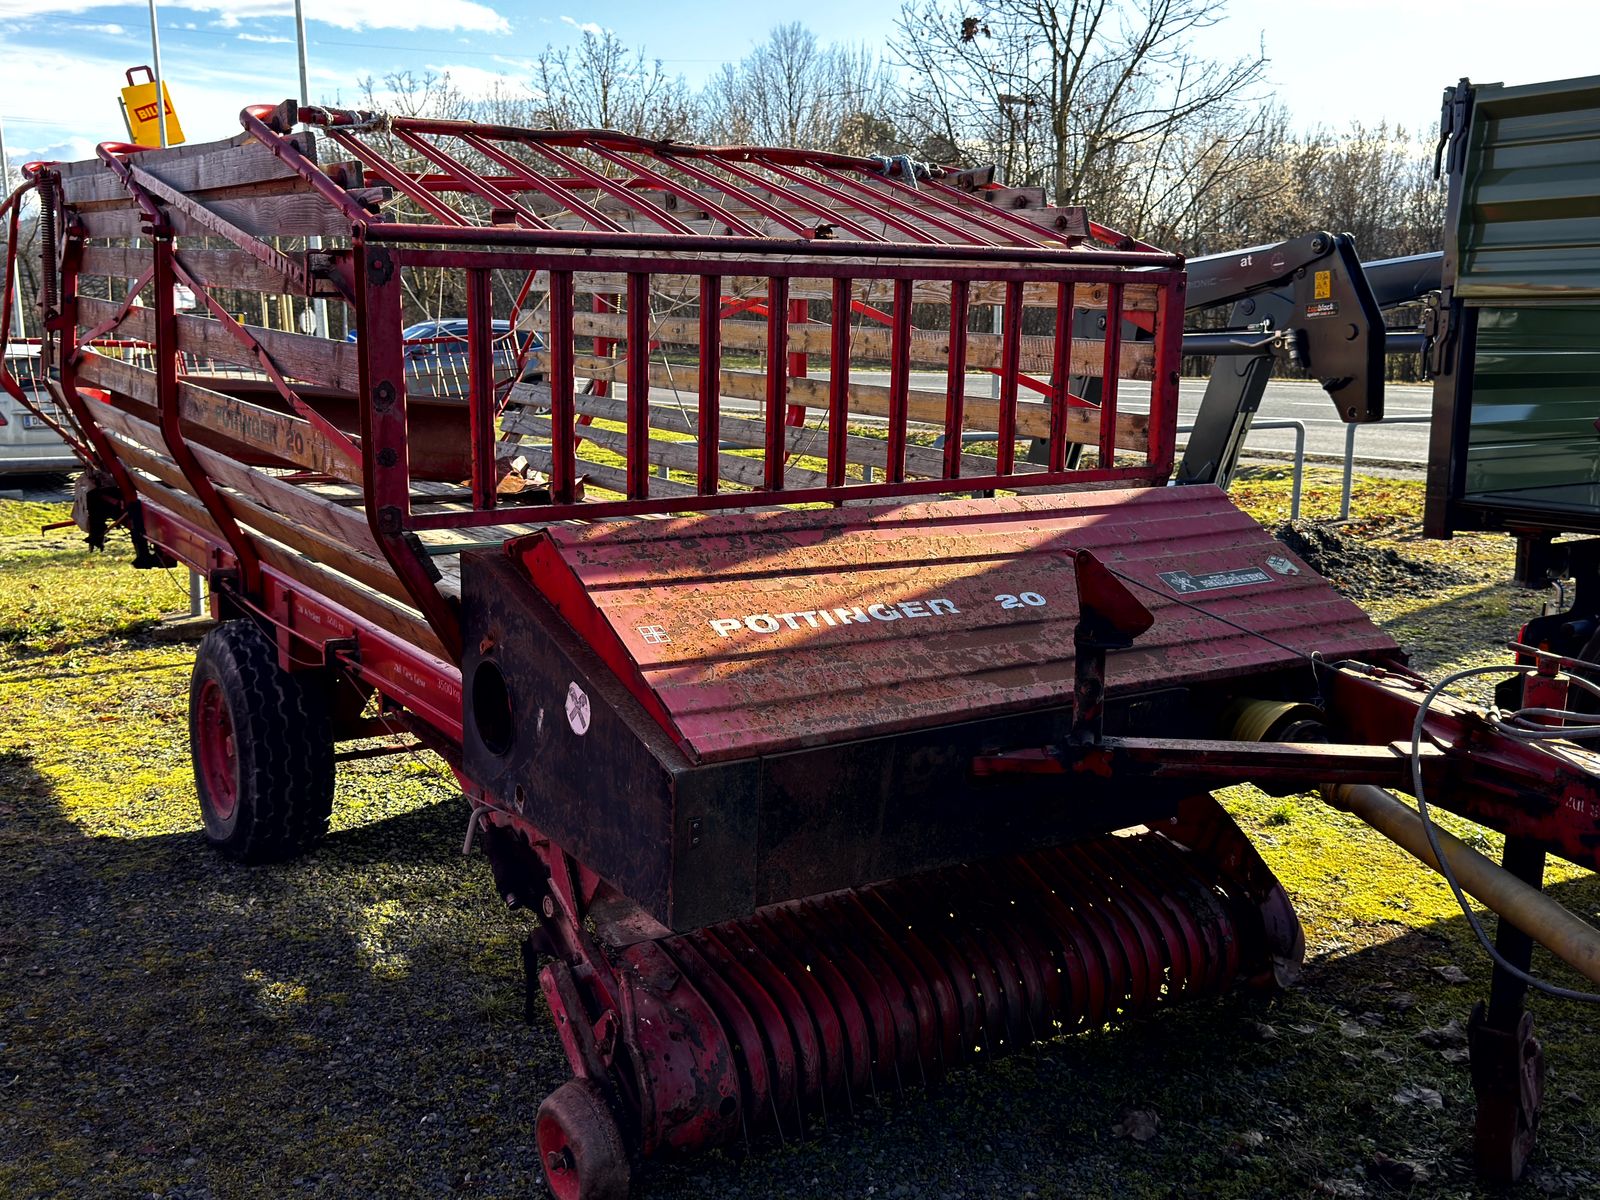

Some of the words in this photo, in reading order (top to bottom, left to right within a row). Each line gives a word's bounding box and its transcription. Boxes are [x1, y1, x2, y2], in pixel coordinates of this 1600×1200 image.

[138, 104, 168, 119] BIL
[1240, 255, 1253, 267] at
[286, 428, 304, 455] 20
[994, 591, 1047, 609] 20
